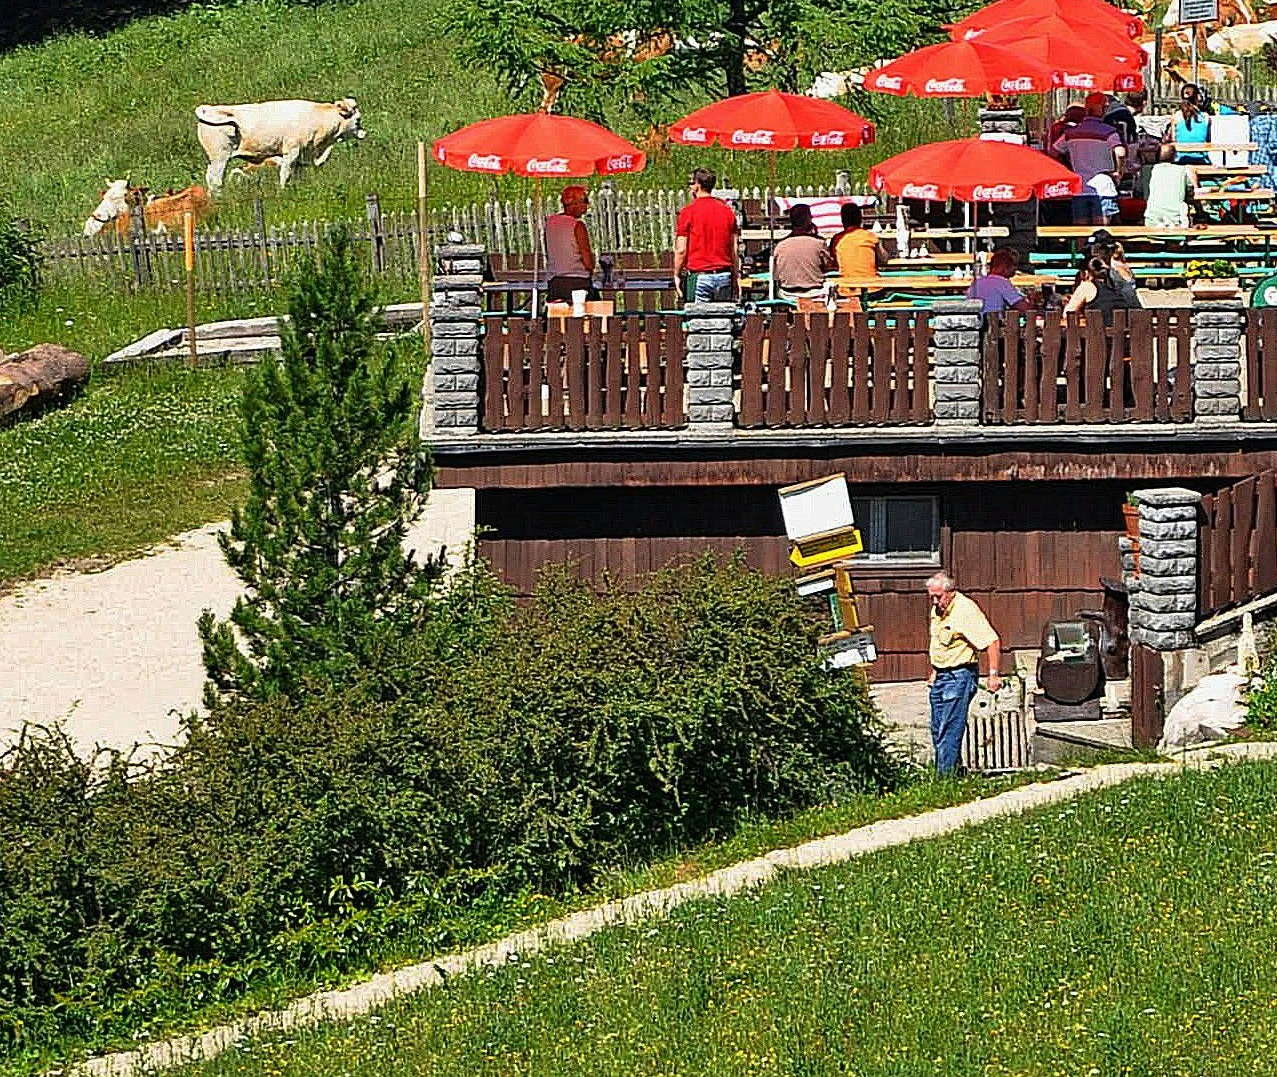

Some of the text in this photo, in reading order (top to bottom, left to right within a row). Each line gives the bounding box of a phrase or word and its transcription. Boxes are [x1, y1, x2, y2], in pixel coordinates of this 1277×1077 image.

[732, 129, 775, 145] Coca-Cola
[527, 158, 570, 172] Coca-Cola
[973, 184, 1015, 200] Coca-Cola
